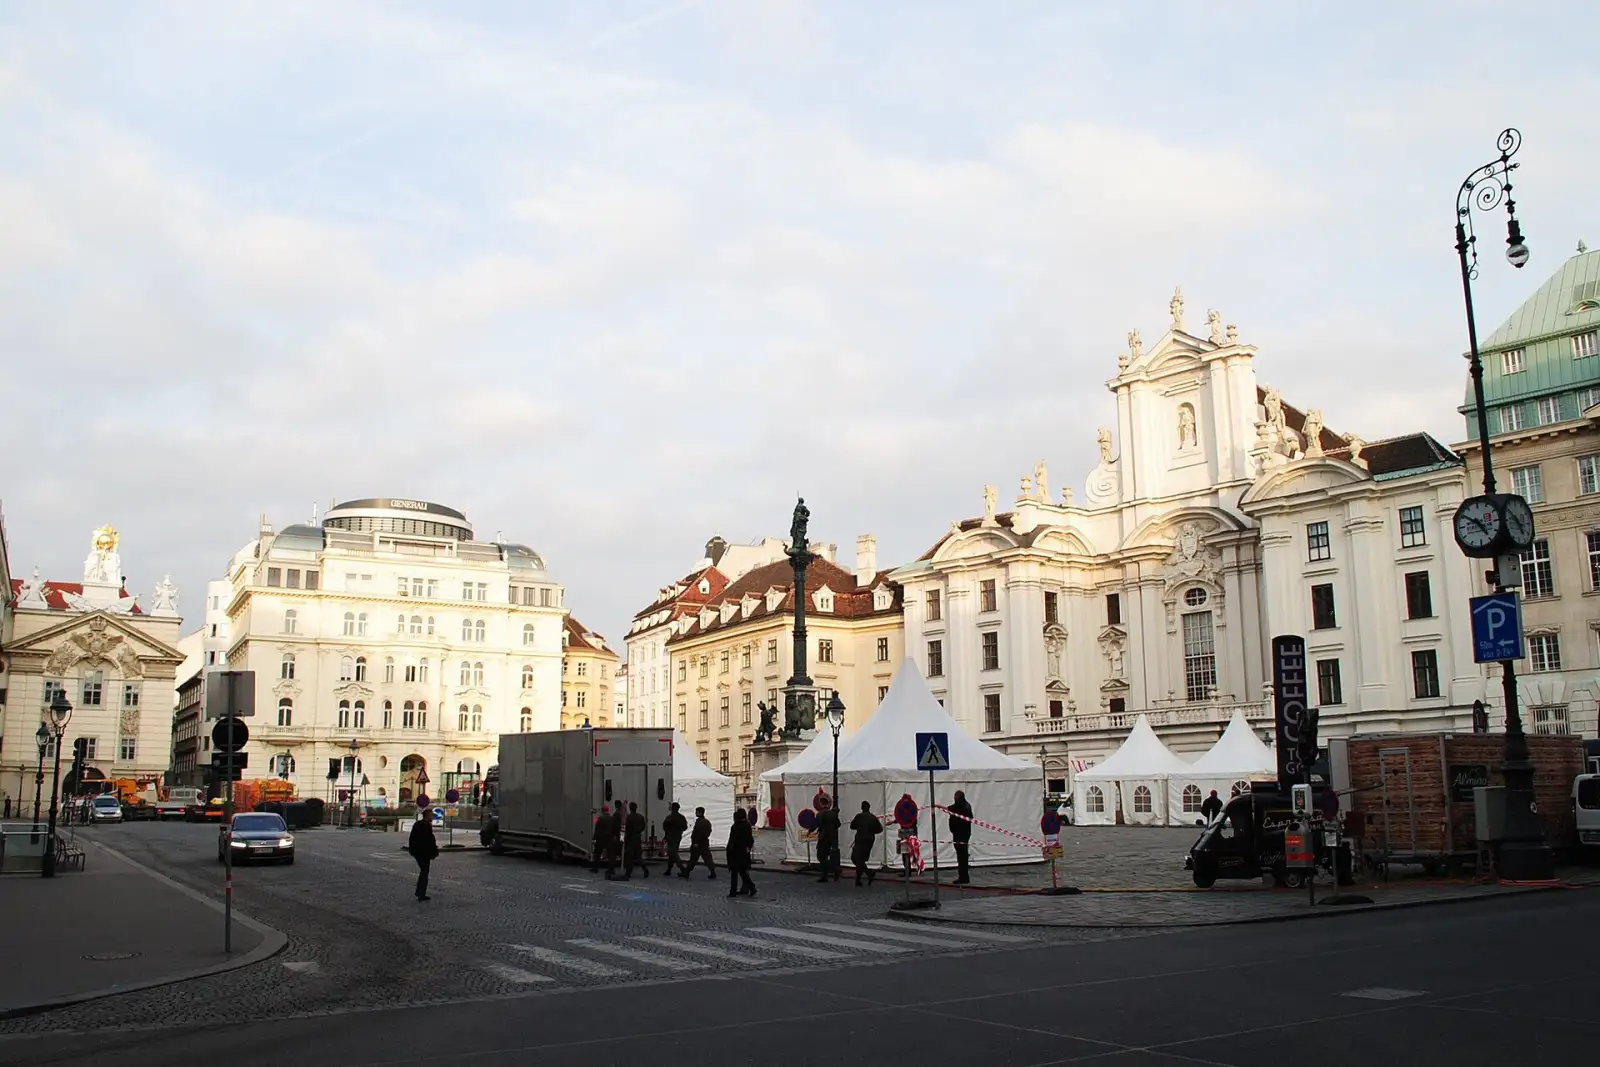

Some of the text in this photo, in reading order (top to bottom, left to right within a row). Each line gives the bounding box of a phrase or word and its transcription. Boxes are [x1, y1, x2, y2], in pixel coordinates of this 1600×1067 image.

[390, 499, 427, 511] GENERALI
[1487, 607, 1506, 640] P
[1280, 644, 1305, 742] COFFEE
